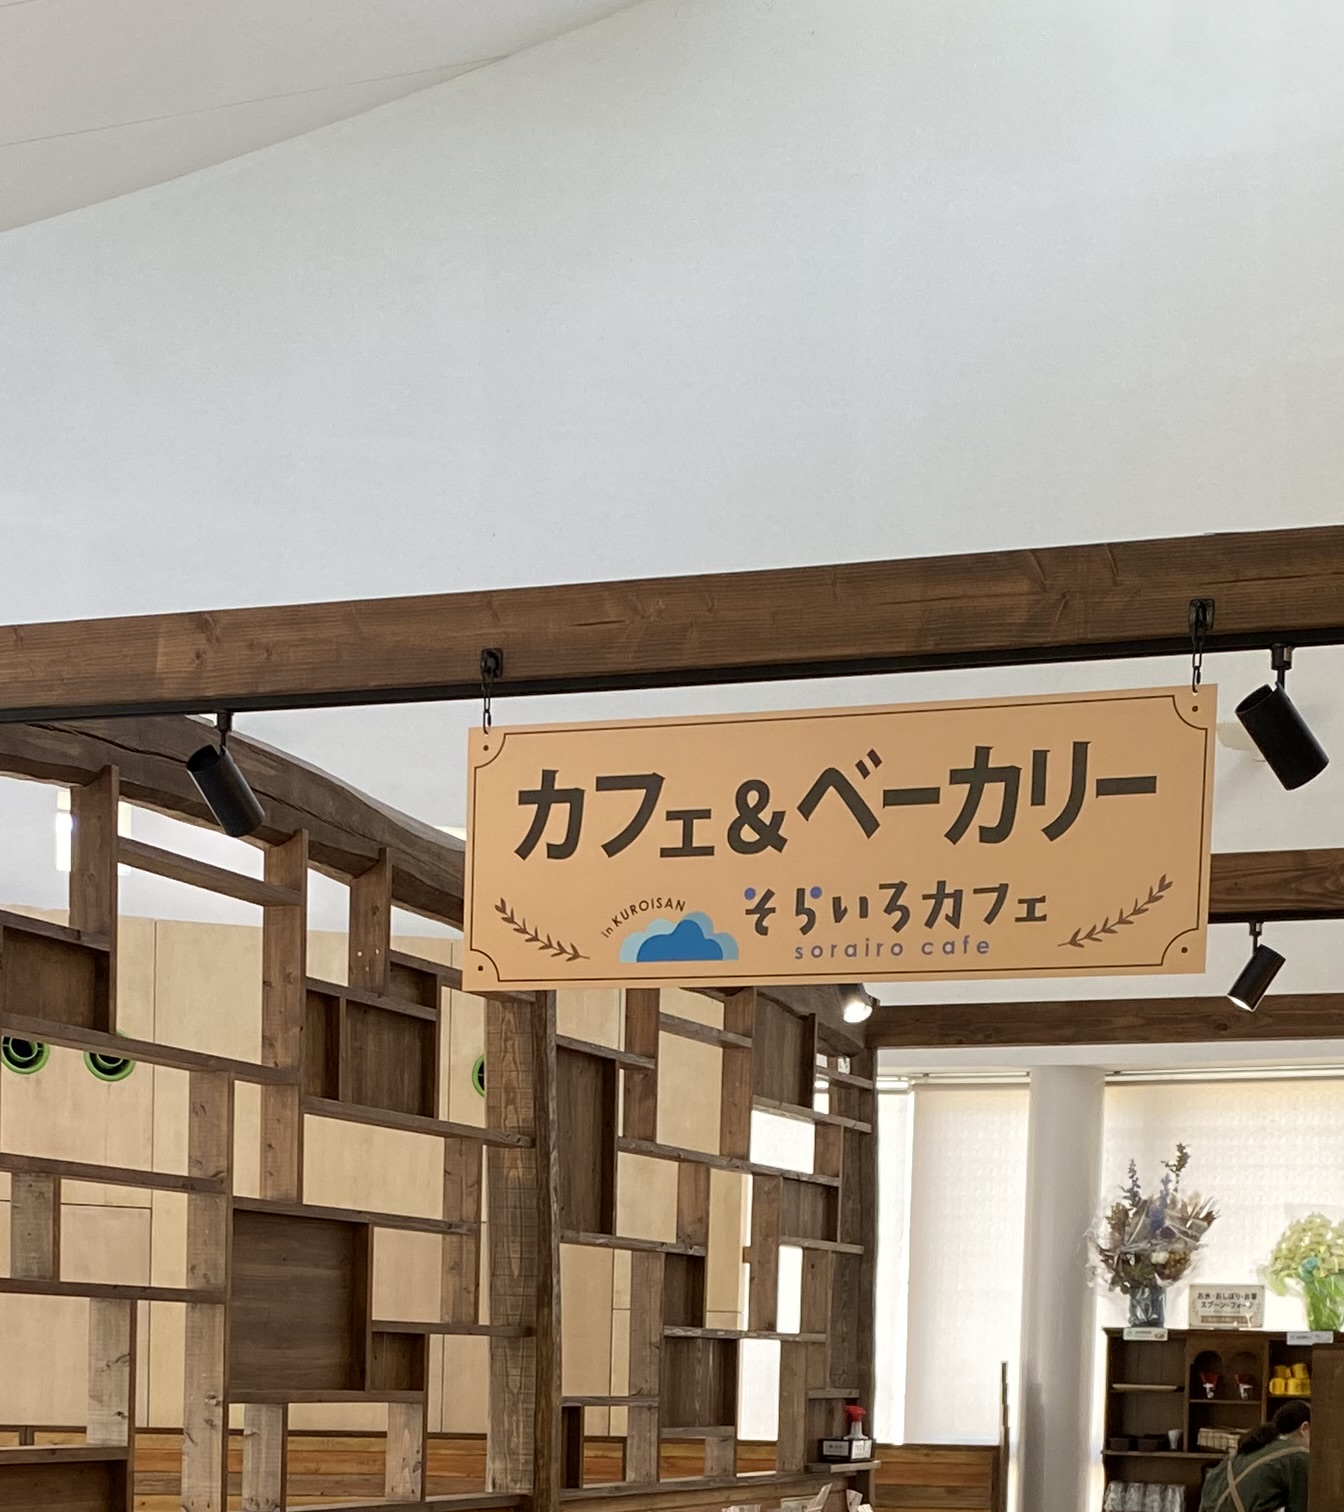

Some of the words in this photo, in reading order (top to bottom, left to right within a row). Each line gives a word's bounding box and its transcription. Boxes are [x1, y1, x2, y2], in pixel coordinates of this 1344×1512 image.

[514, 741, 1158, 861] カフェ&ベーカリー
[601, 926, 614, 939] in
[612, 897, 686, 928] KUROISAN
[744, 879, 1049, 937] そらいろカフェ
[794, 938, 906, 961] sorairo
[921, 935, 990, 957] cafe
